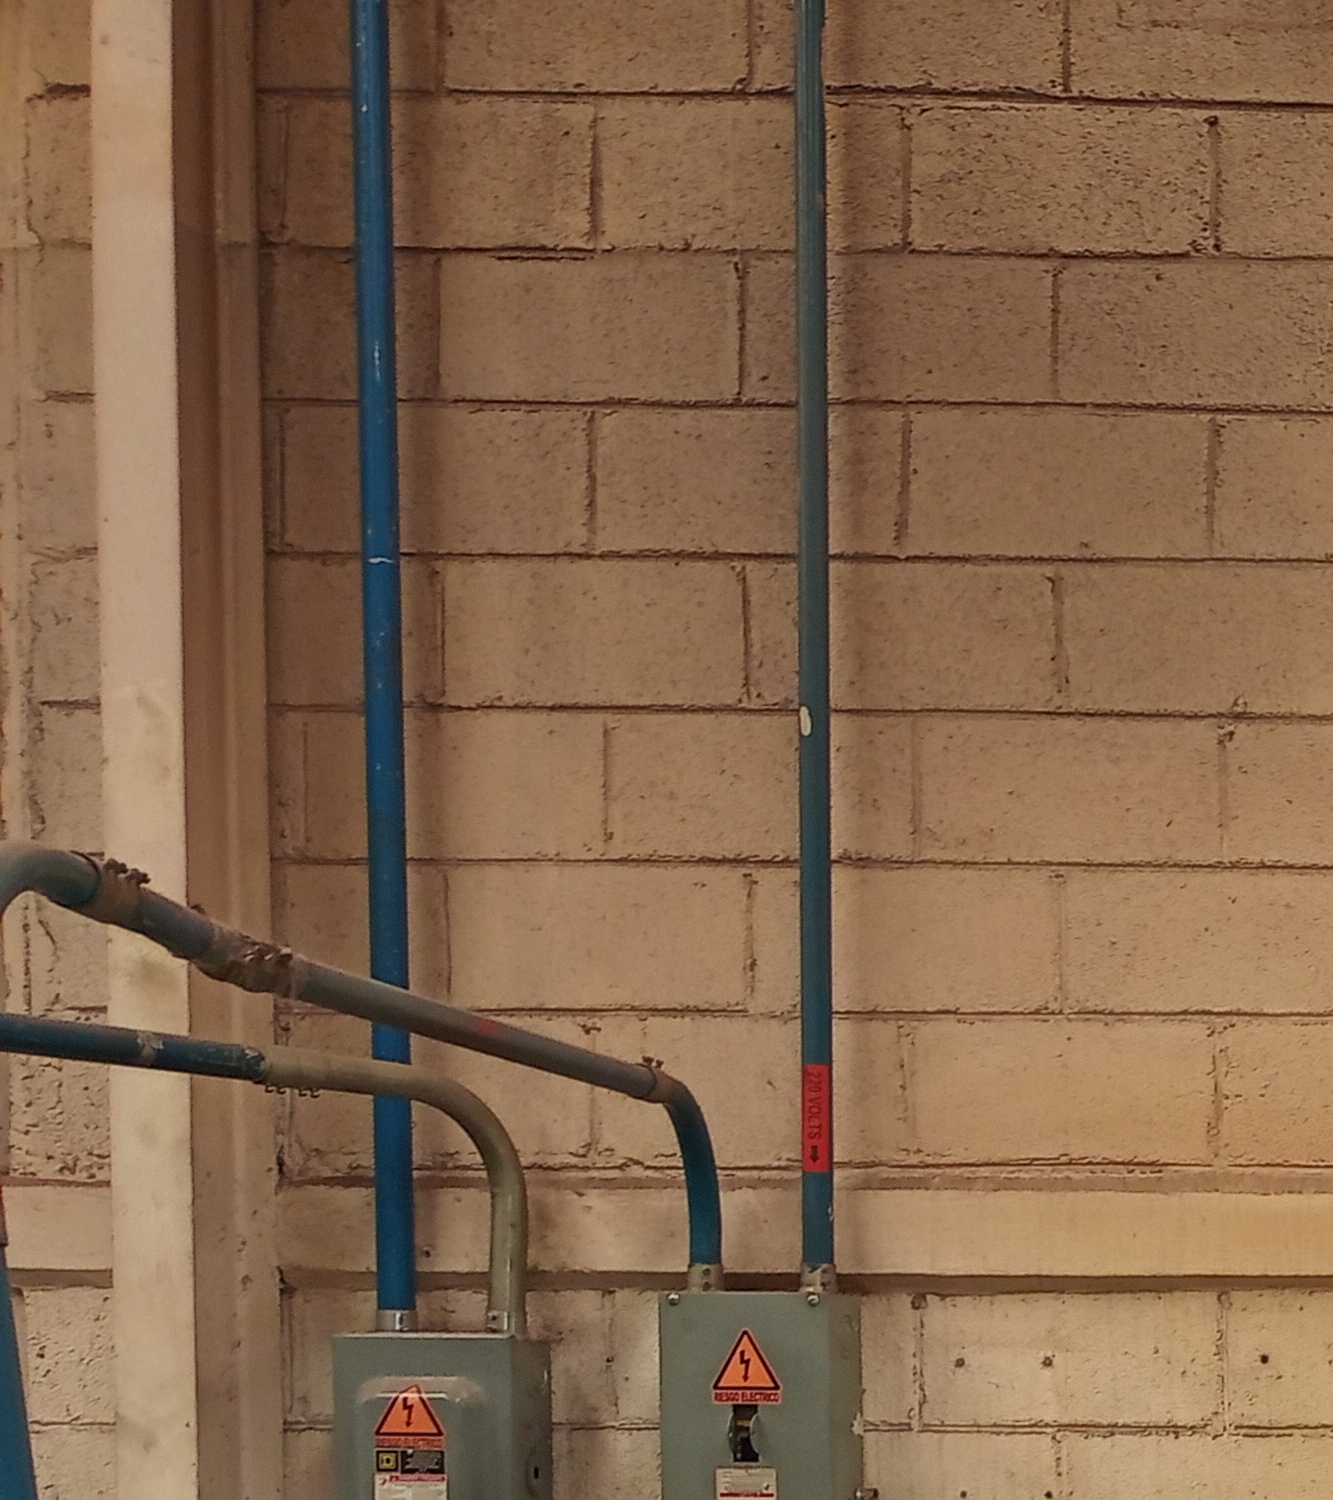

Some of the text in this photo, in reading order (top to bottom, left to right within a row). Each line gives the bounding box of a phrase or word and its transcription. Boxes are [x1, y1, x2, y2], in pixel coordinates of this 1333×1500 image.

[807, 1097, 822, 1141] VOLTS
[714, 1391, 780, 1403] RIESGO ELECTRICO
